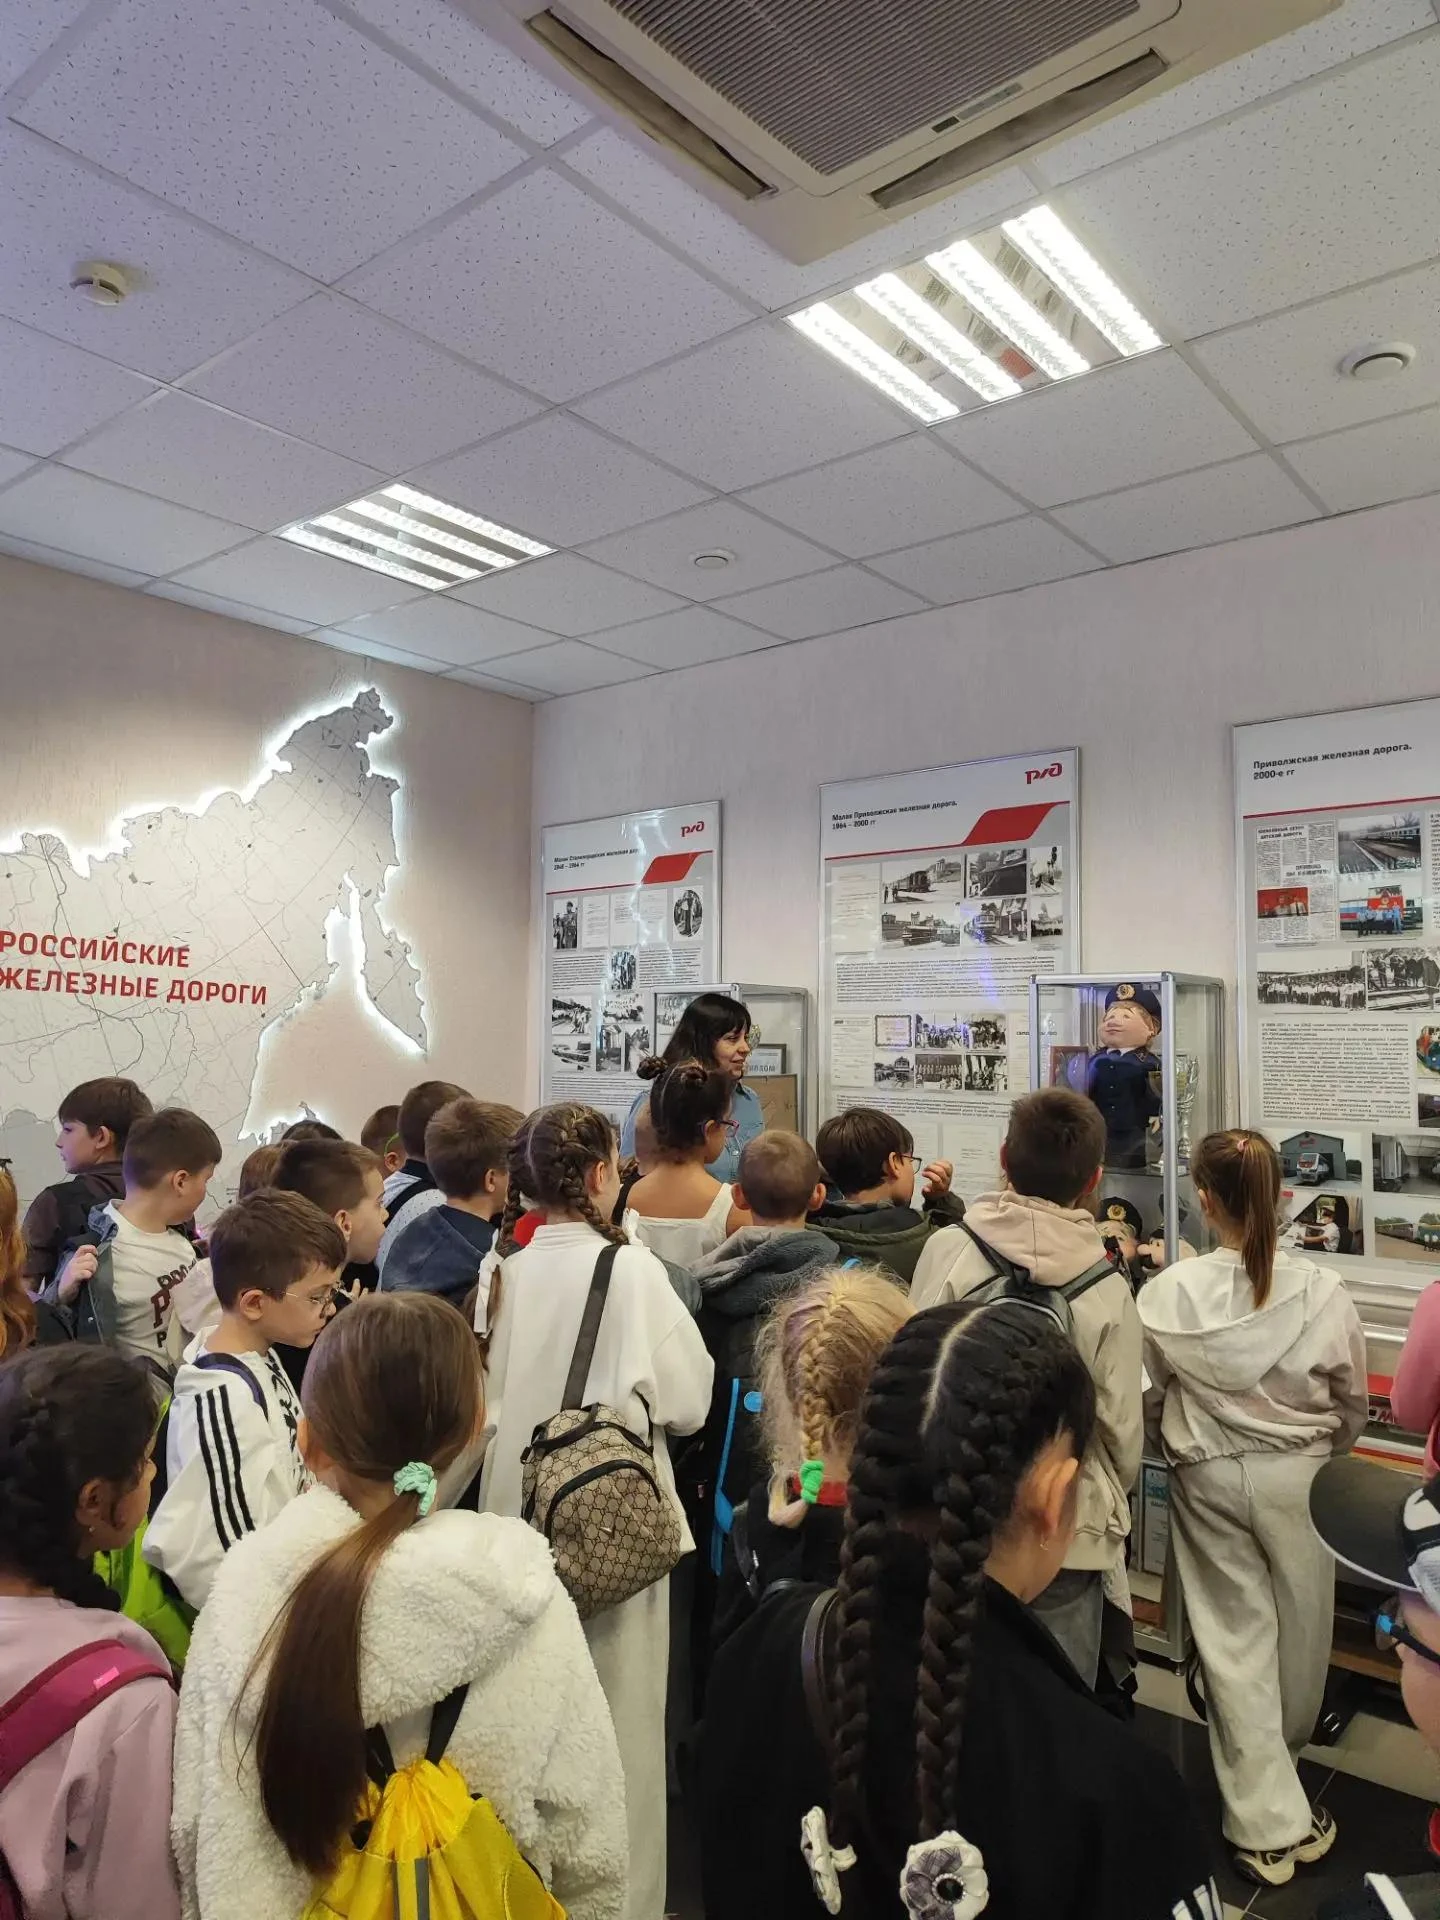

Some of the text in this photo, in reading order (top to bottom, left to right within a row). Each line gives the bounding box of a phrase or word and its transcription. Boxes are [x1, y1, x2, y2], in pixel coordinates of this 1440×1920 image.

[1253, 743, 1412, 770] Приволжская железная дорога.
[1253, 769, 1284, 780] 2000-е
[853, 809, 897, 819] Приволжская
[898, 804, 931, 813] железная
[853, 819, 869, 828] 2000
[0, 930, 190, 968] РОССИЙСКИЕ
[0, 967, 267, 1005] ЖЕЛЕЗНЫЕ ДОРОГИ
